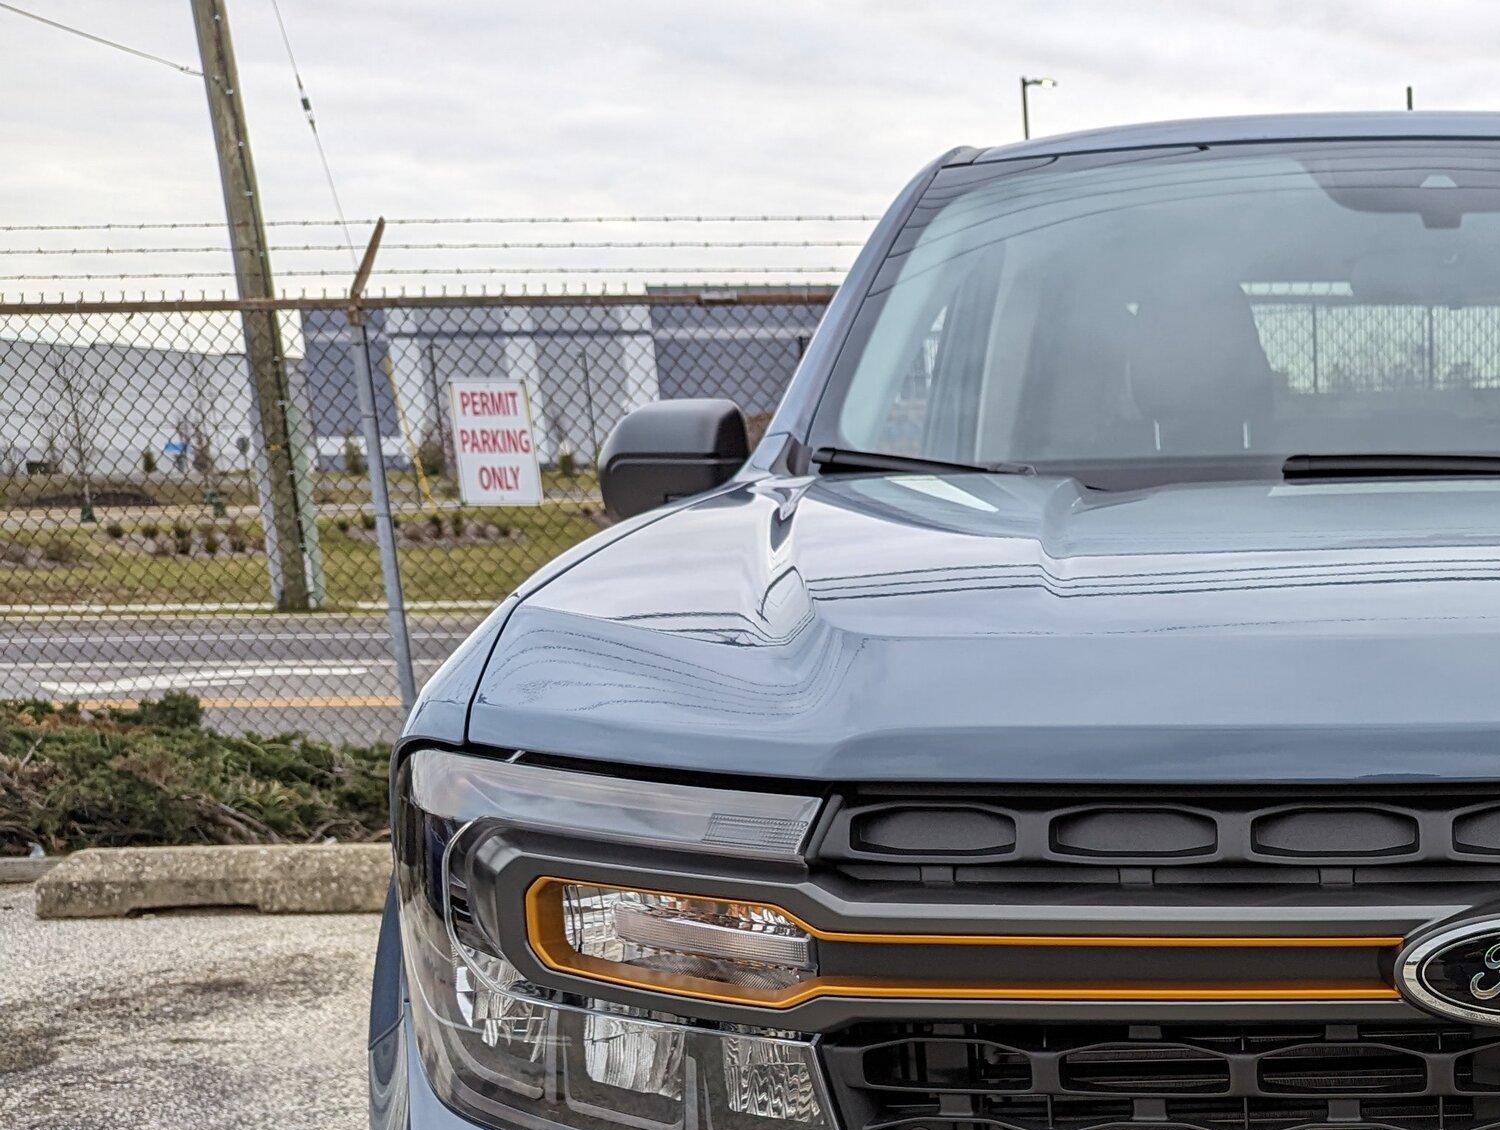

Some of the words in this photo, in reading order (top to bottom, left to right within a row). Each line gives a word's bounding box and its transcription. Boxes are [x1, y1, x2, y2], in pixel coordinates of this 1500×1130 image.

[460, 391, 519, 416] PERMIT
[460, 429, 532, 453] PARKING
[479, 466, 520, 491] ONLY
